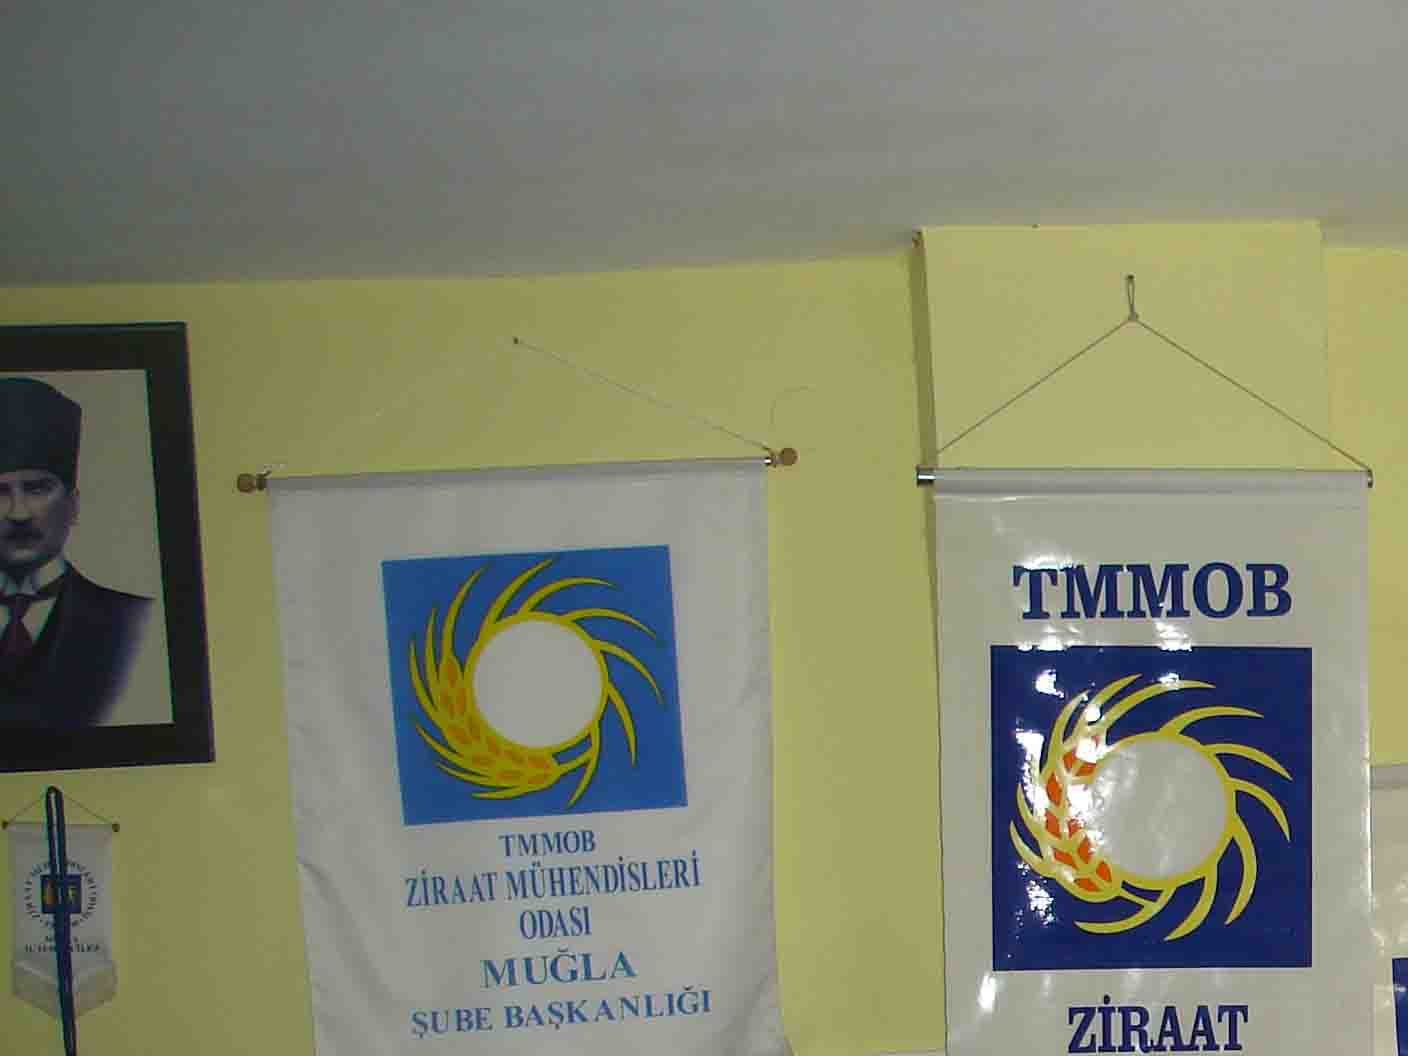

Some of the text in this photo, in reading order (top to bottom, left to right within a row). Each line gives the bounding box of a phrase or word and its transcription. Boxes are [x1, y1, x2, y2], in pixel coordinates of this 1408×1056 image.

[1012, 562, 1292, 619] TMMOB
[498, 829, 596, 857] TMMOB
[405, 849, 702, 907] ZİRAAT MÜHENDİSLERİ
[519, 906, 592, 940] ODASI
[479, 947, 638, 988] MUĞLA
[410, 985, 713, 1039] ŞUBE BAŞKANLIĞI
[1068, 994, 1249, 1054] ZİRAAT
